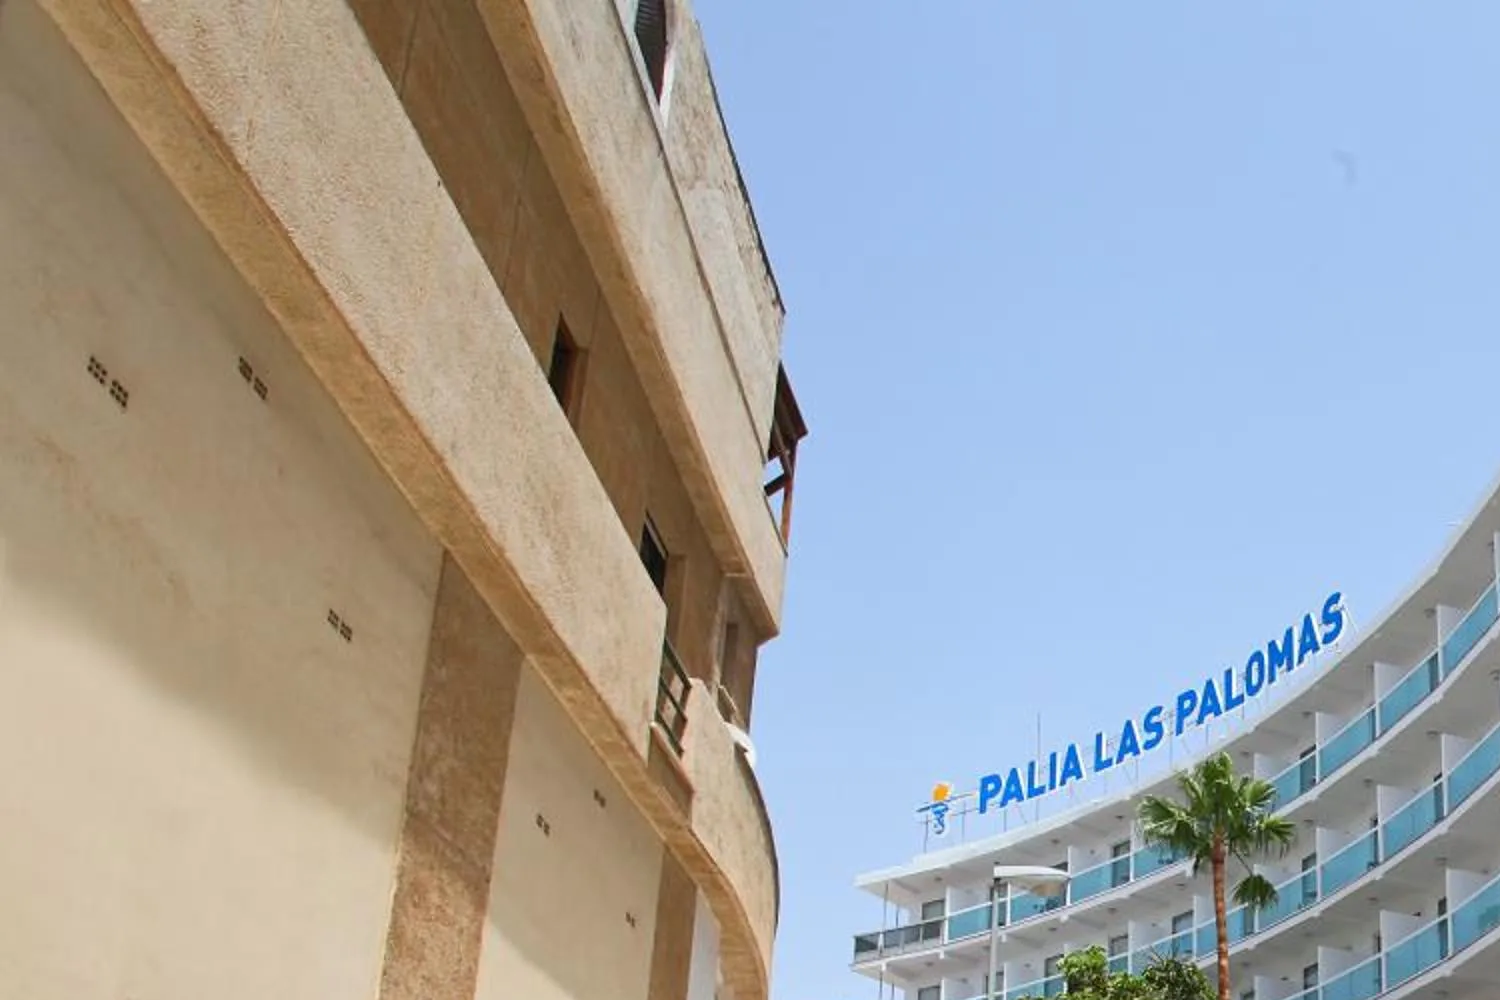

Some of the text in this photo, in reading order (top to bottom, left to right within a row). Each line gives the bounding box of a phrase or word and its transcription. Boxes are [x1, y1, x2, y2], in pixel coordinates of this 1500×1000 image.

[978, 590, 1345, 815] PALIA LAS PALOMAS
